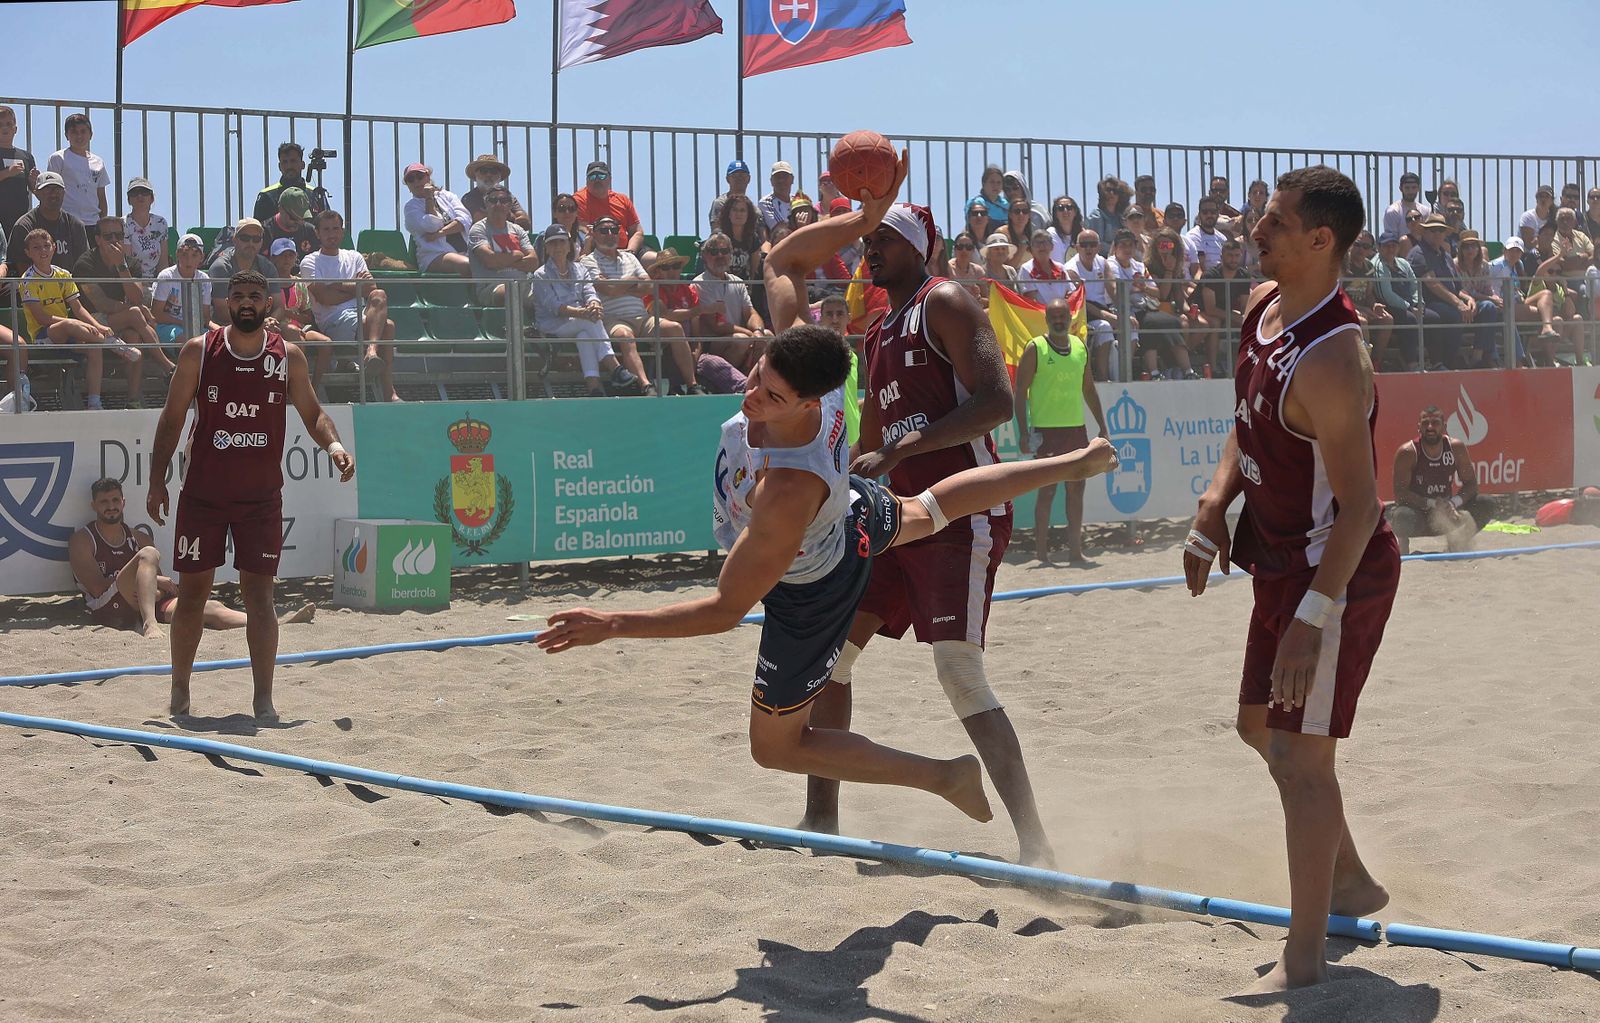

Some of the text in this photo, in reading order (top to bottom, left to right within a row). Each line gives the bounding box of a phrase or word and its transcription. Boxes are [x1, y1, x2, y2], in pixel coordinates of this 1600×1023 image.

[900, 303, 922, 338] 10
[263, 354, 287, 381] 94
[1266, 331, 1300, 382] 24
[879, 380, 901, 410] QAT
[225, 401, 260, 419] QAT
[231, 432, 268, 448] QNB
[553, 448, 593, 470] Real
[1181, 446, 1200, 466] La
[554, 473, 655, 497] Federación
[555, 501, 639, 528] Española
[177, 535, 201, 561] 94
[554, 528, 686, 552] de Balonmano
[392, 587, 436, 599] Iberdrola
[932, 615, 956, 624] Kempa
